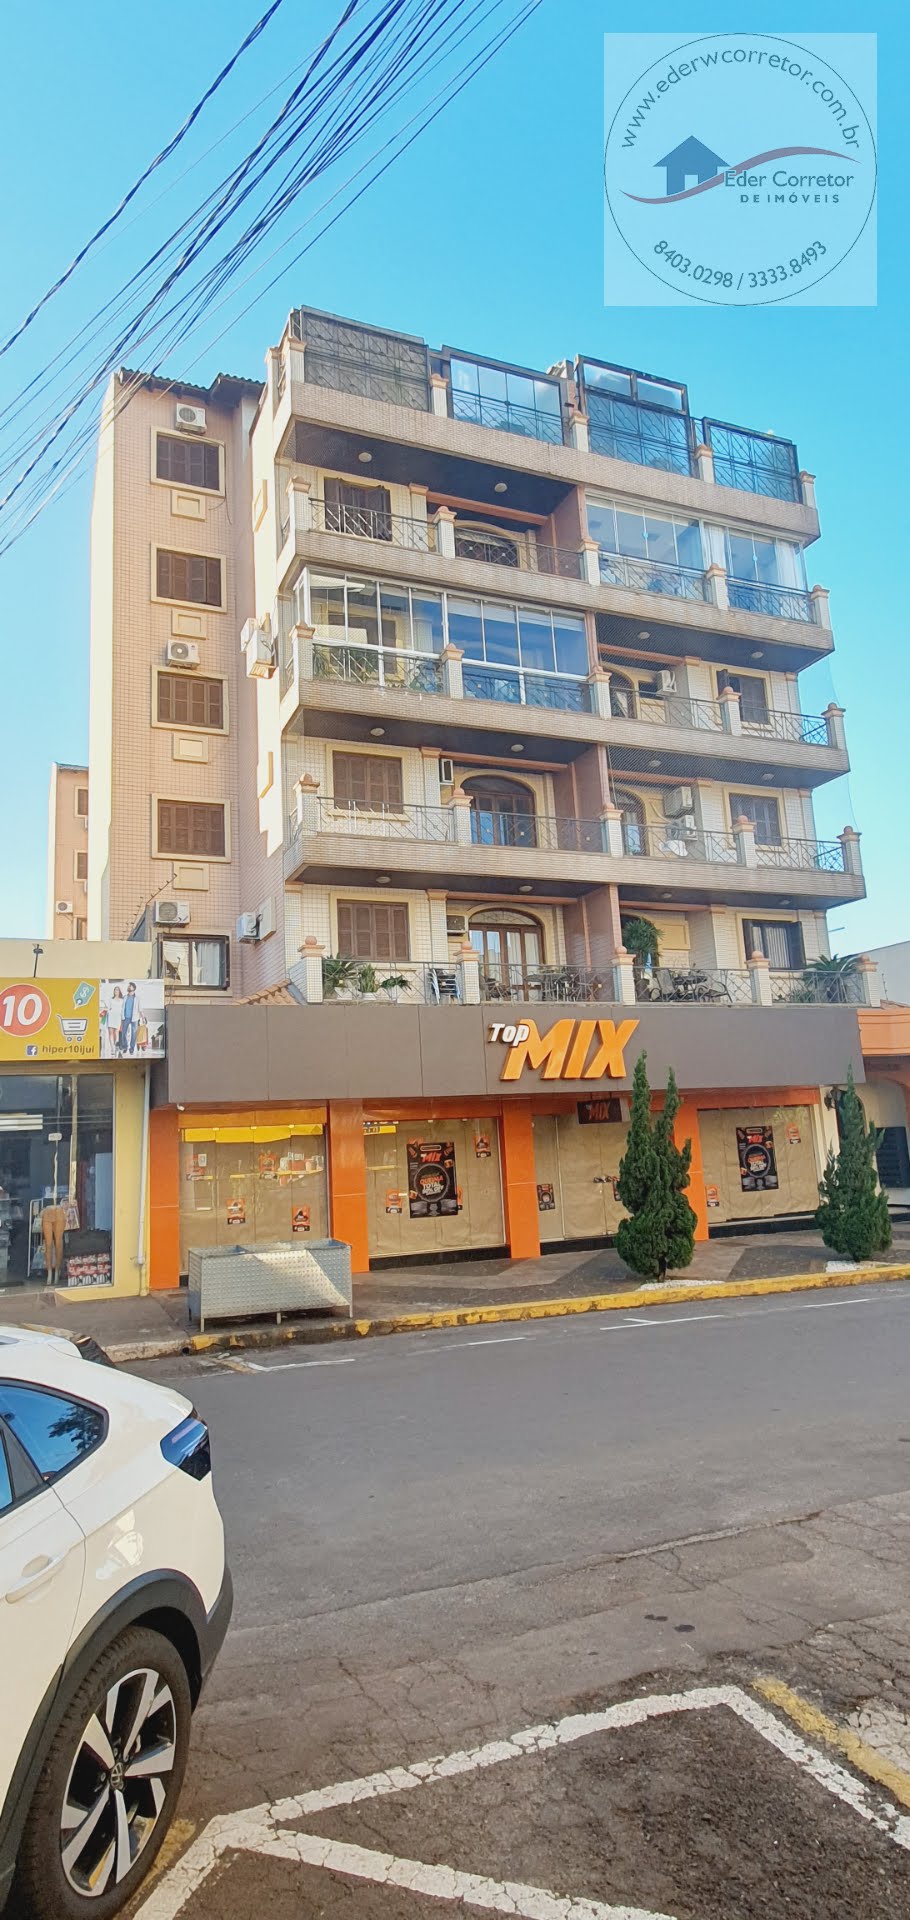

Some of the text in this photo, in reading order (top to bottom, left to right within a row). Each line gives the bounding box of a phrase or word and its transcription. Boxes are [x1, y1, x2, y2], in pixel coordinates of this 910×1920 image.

[3, 993, 43, 1027] 10
[42, 1045, 94, 1055] hiper10ijui
[489, 1023, 530, 1048] Top
[500, 1018, 641, 1082] MIX
